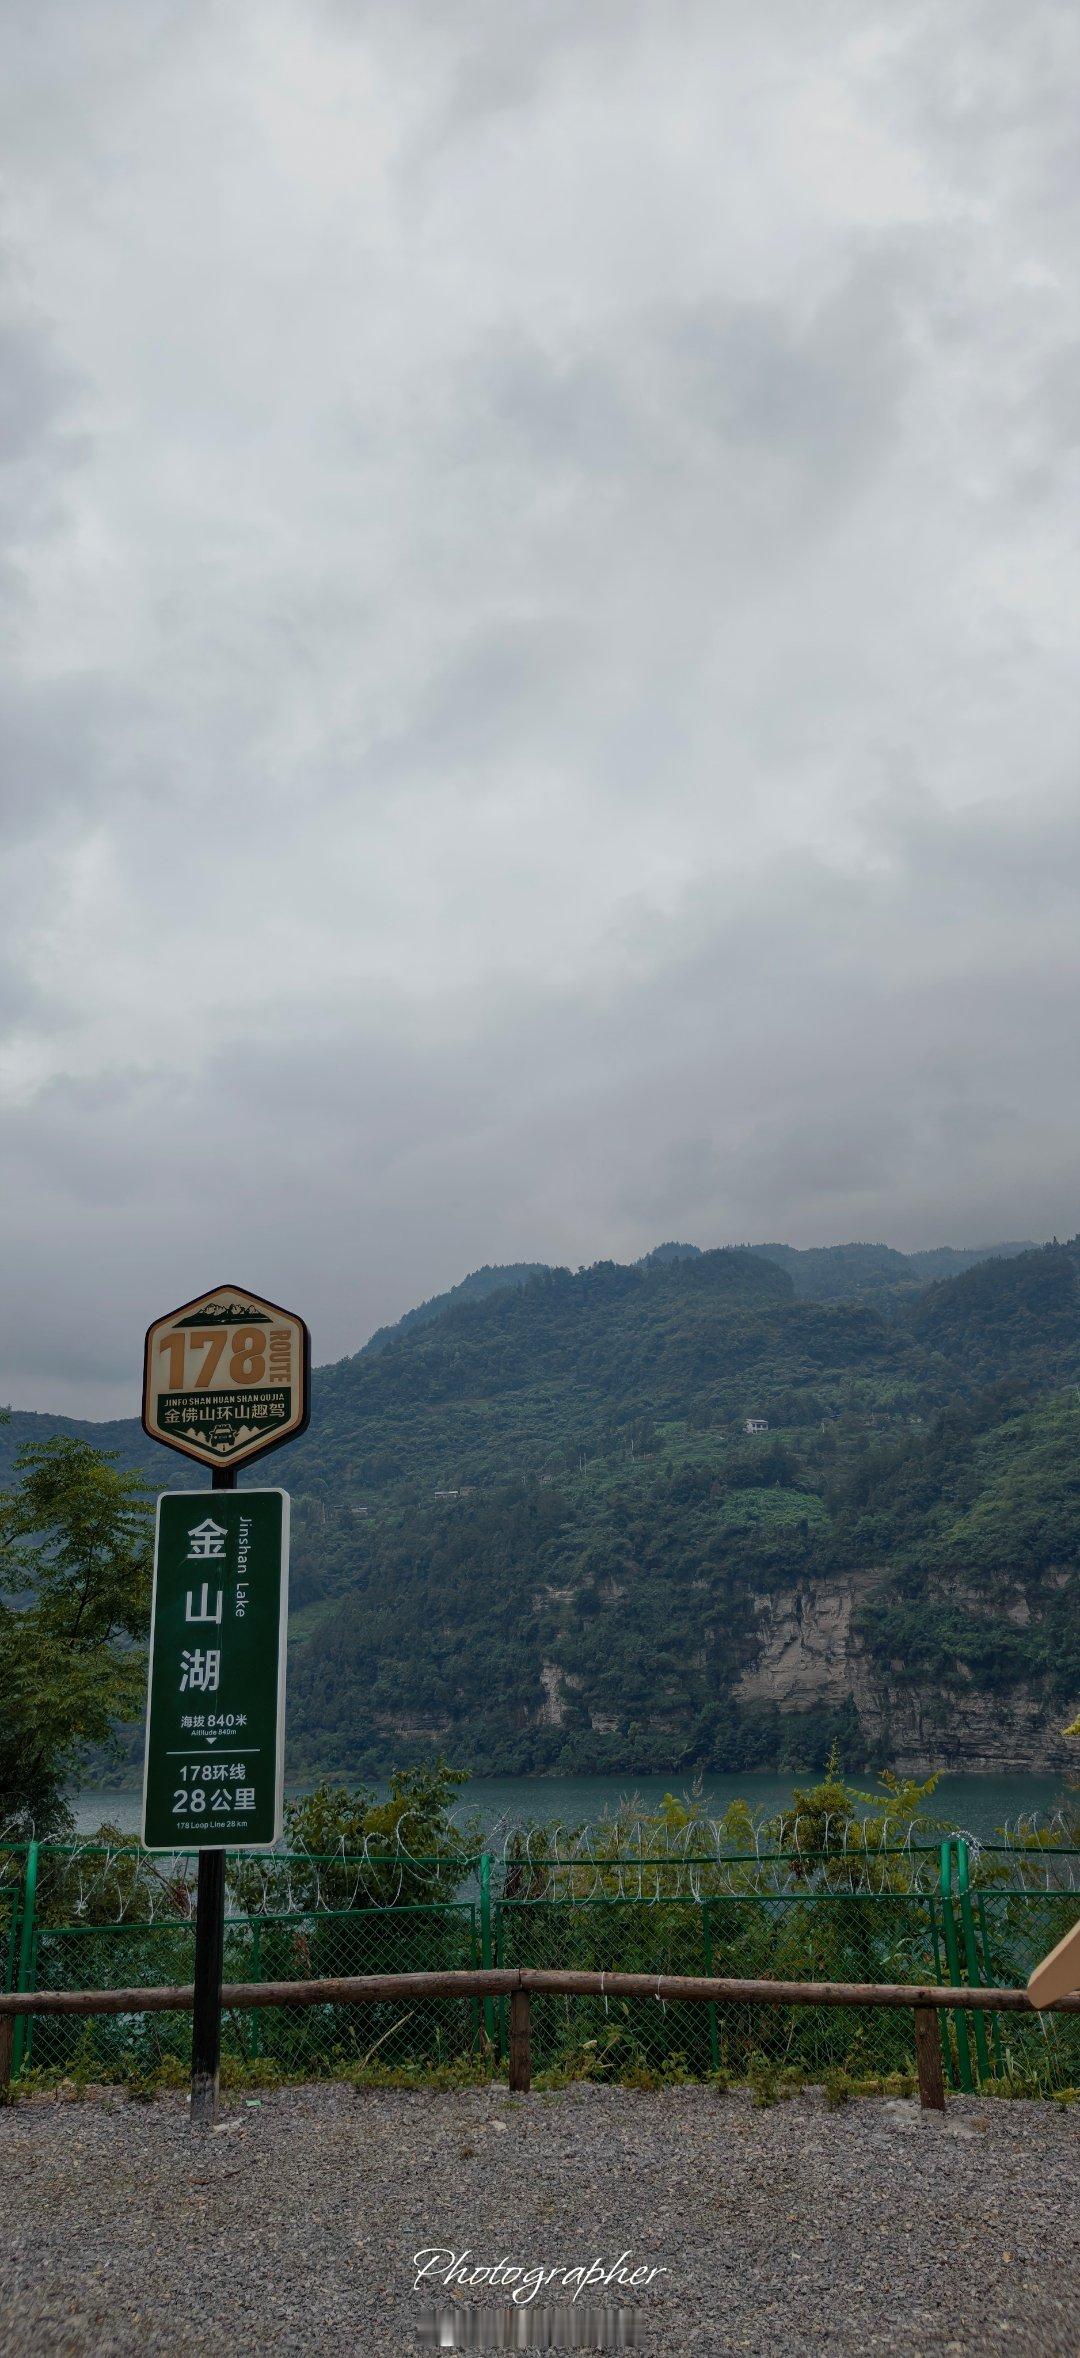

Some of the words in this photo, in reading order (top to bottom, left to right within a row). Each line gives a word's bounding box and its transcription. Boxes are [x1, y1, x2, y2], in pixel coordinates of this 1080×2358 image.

[159, 1327, 267, 1389] 178
[269, 1330, 292, 1384] ROUTE
[164, 1399, 188, 1407] JINFO
[189, 1396, 212, 1406] SHAN
[212, 1395, 236, 1404] HUAN
[236, 1394, 259, 1403] SHAN
[164, 1403, 286, 1424] 金佛山环山趣驾
[237, 1516, 253, 1574] Jinshan
[179, 1518, 229, 1692] 金山湖
[235, 1583, 250, 1618] Lake
[180, 1713, 248, 1728] 海拔840米
[218, 1728, 237, 1736] 840m
[179, 1763, 246, 1782] 178环线
[171, 1787, 257, 1813] 28公里
[190, 1822, 209, 1830] Loop
[226, 1820, 236, 1828] 28
[236, 1820, 248, 1828] km
